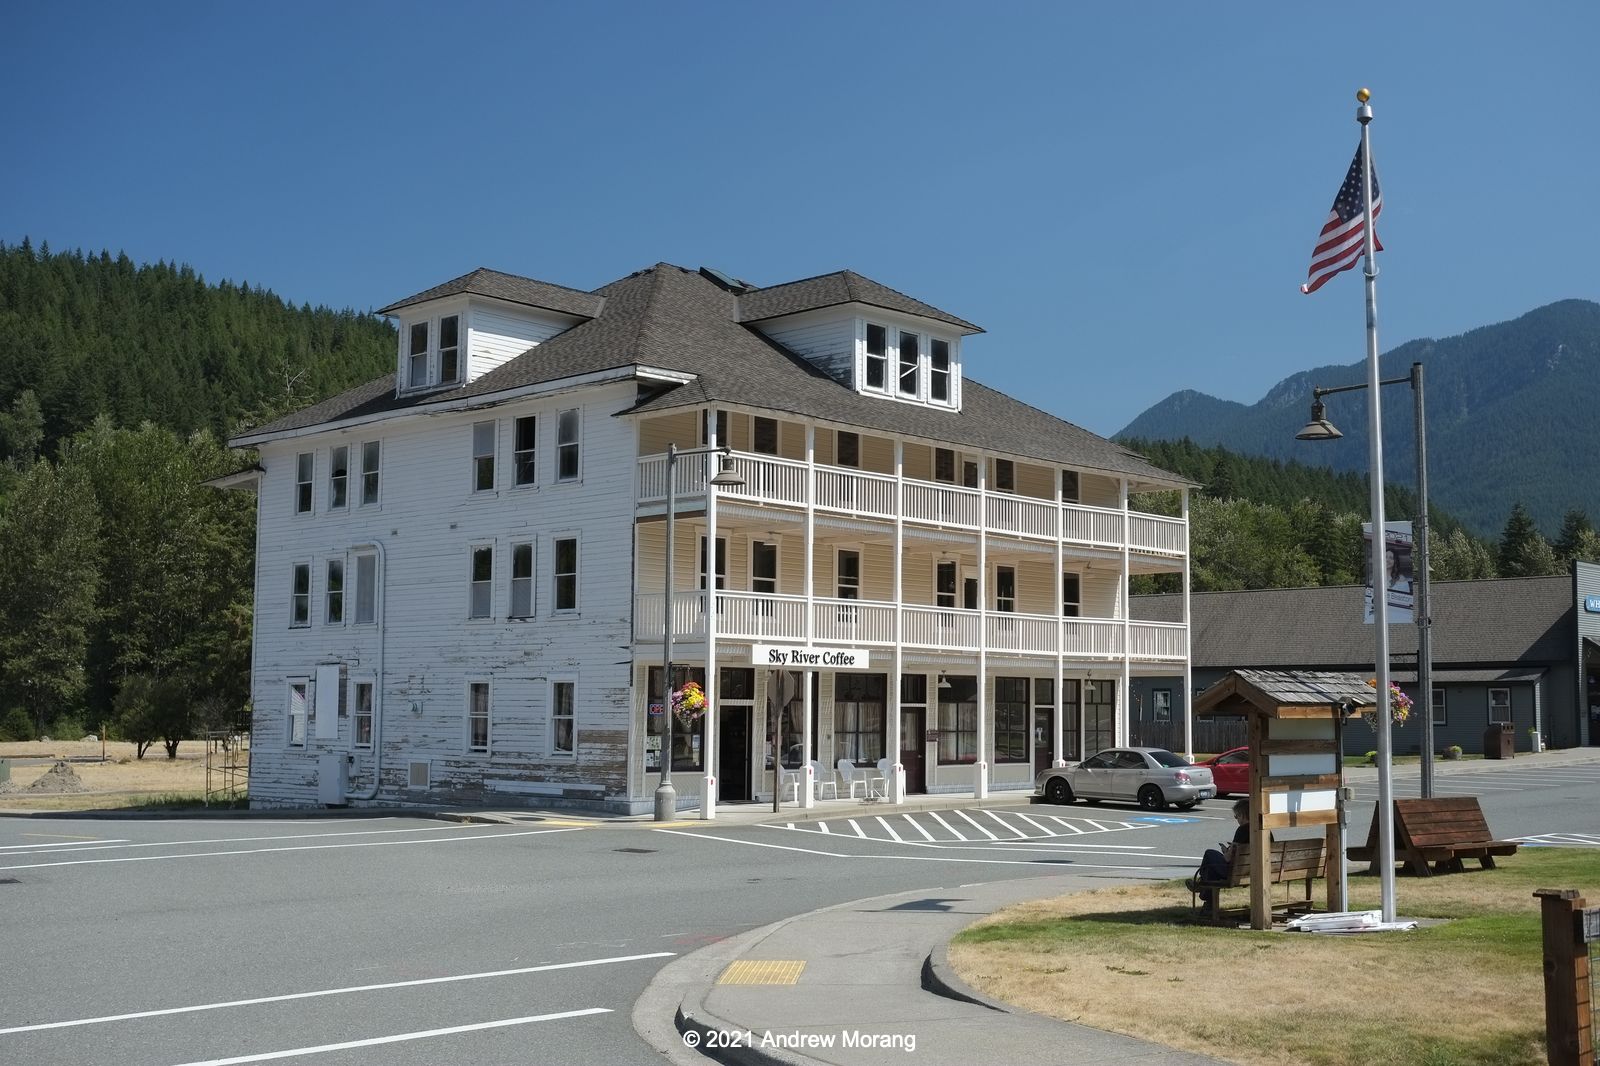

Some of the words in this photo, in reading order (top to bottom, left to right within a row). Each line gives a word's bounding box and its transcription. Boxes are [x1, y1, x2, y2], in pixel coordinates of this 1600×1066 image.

[768, 648, 788, 664] Sky
[791, 649, 820, 663] River
[822, 651, 855, 665] Coffee
